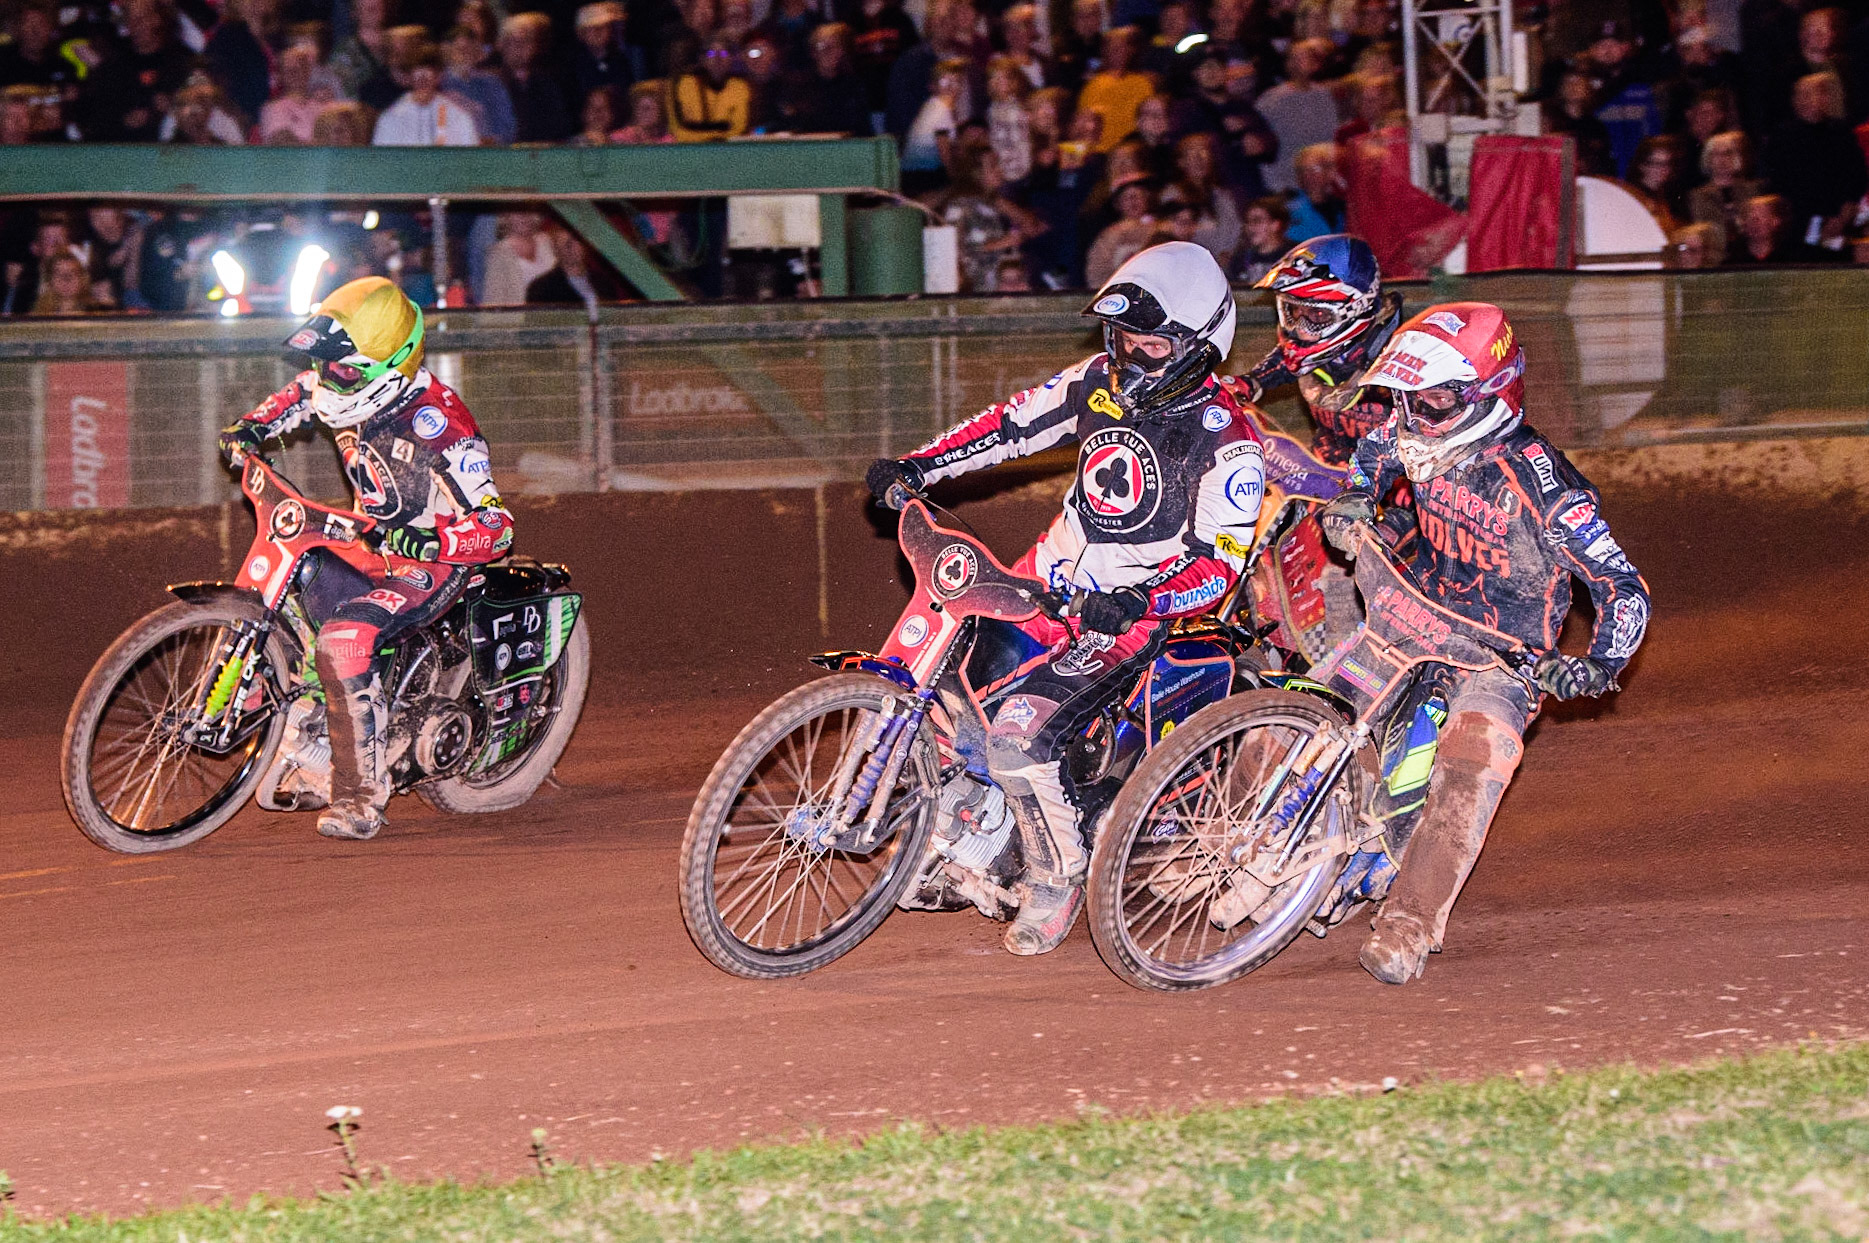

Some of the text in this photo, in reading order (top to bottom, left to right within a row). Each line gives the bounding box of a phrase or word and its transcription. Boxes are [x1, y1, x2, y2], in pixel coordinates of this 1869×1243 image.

[1491, 321, 1515, 362] Nick
[420, 412, 439, 430] ATPI
[1084, 432, 1120, 456] BELLE
[1141, 456, 1157, 491] ACES
[1532, 456, 1557, 493] UNIT
[1234, 481, 1261, 497] ATPI
[1429, 475, 1510, 536] PARRYS
[903, 623, 923, 640] ATPI
[1386, 589, 1452, 645] PARRYS
